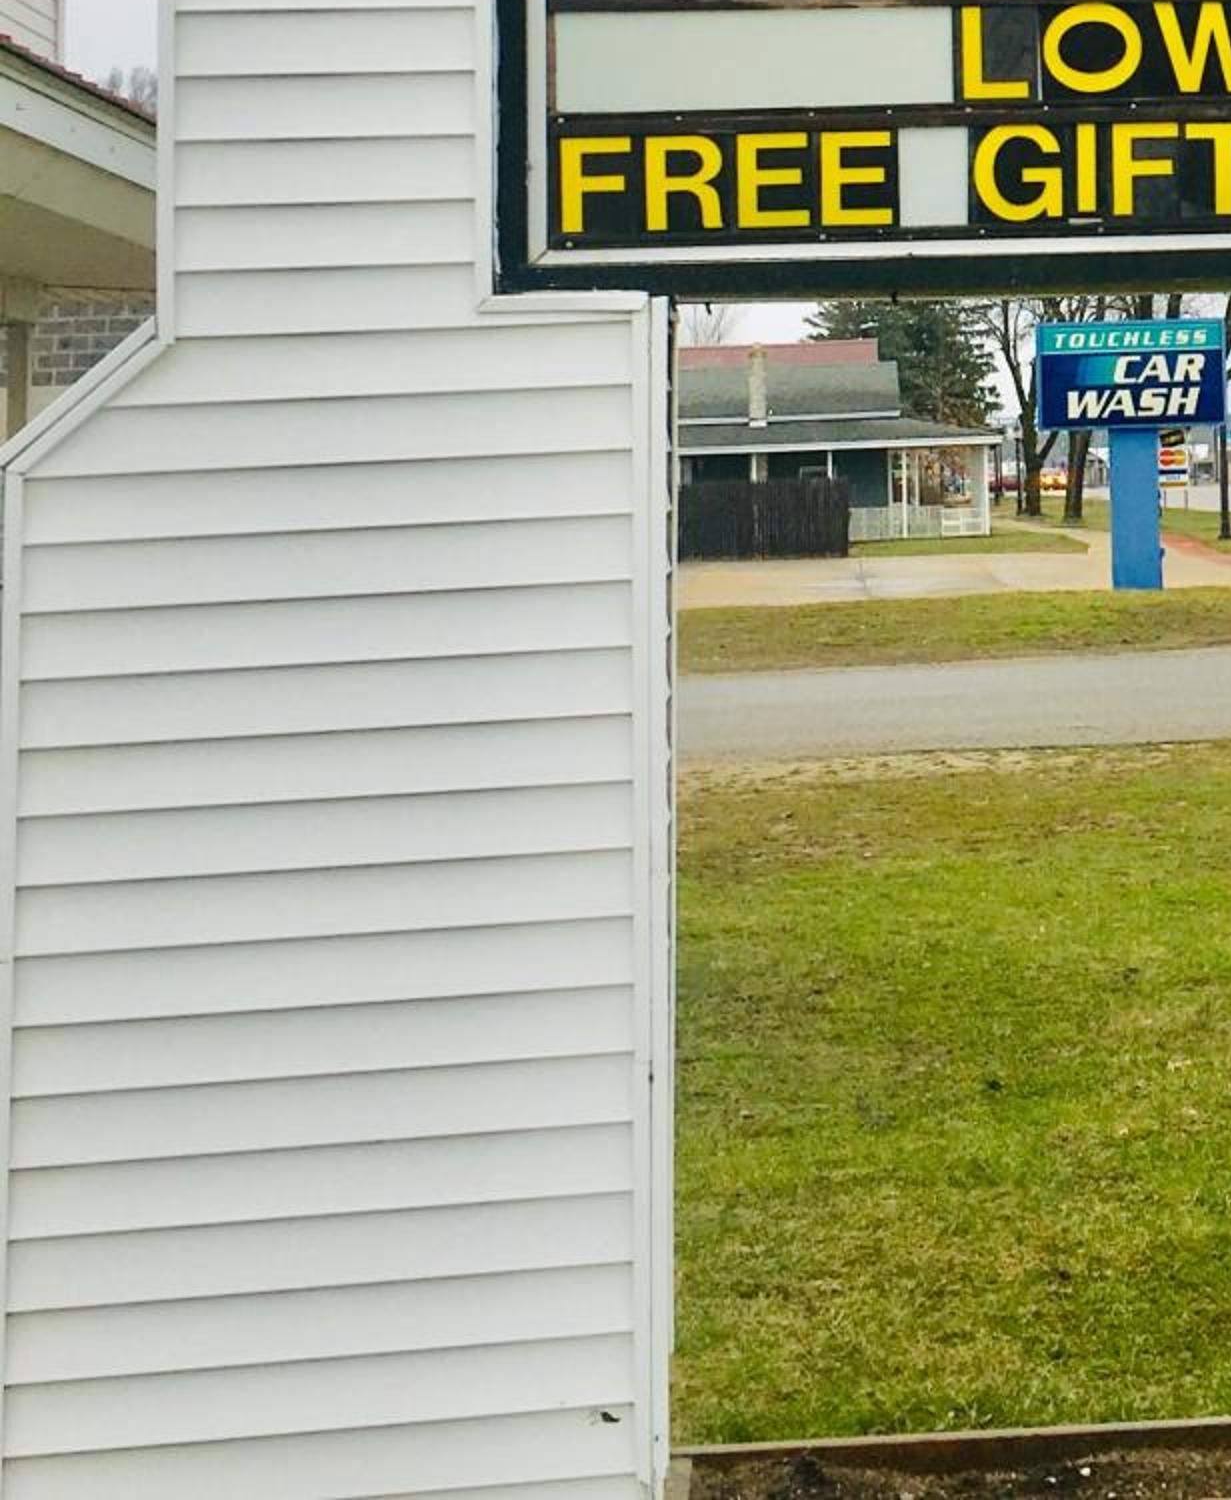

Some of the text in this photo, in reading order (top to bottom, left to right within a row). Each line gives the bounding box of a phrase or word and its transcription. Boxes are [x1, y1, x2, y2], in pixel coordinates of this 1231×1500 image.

[560, 131, 893, 233] FREE
[1055, 329, 1207, 349] TOUCHLESS
[1114, 353, 1205, 384] CAR
[1067, 387, 1200, 419] WASH
